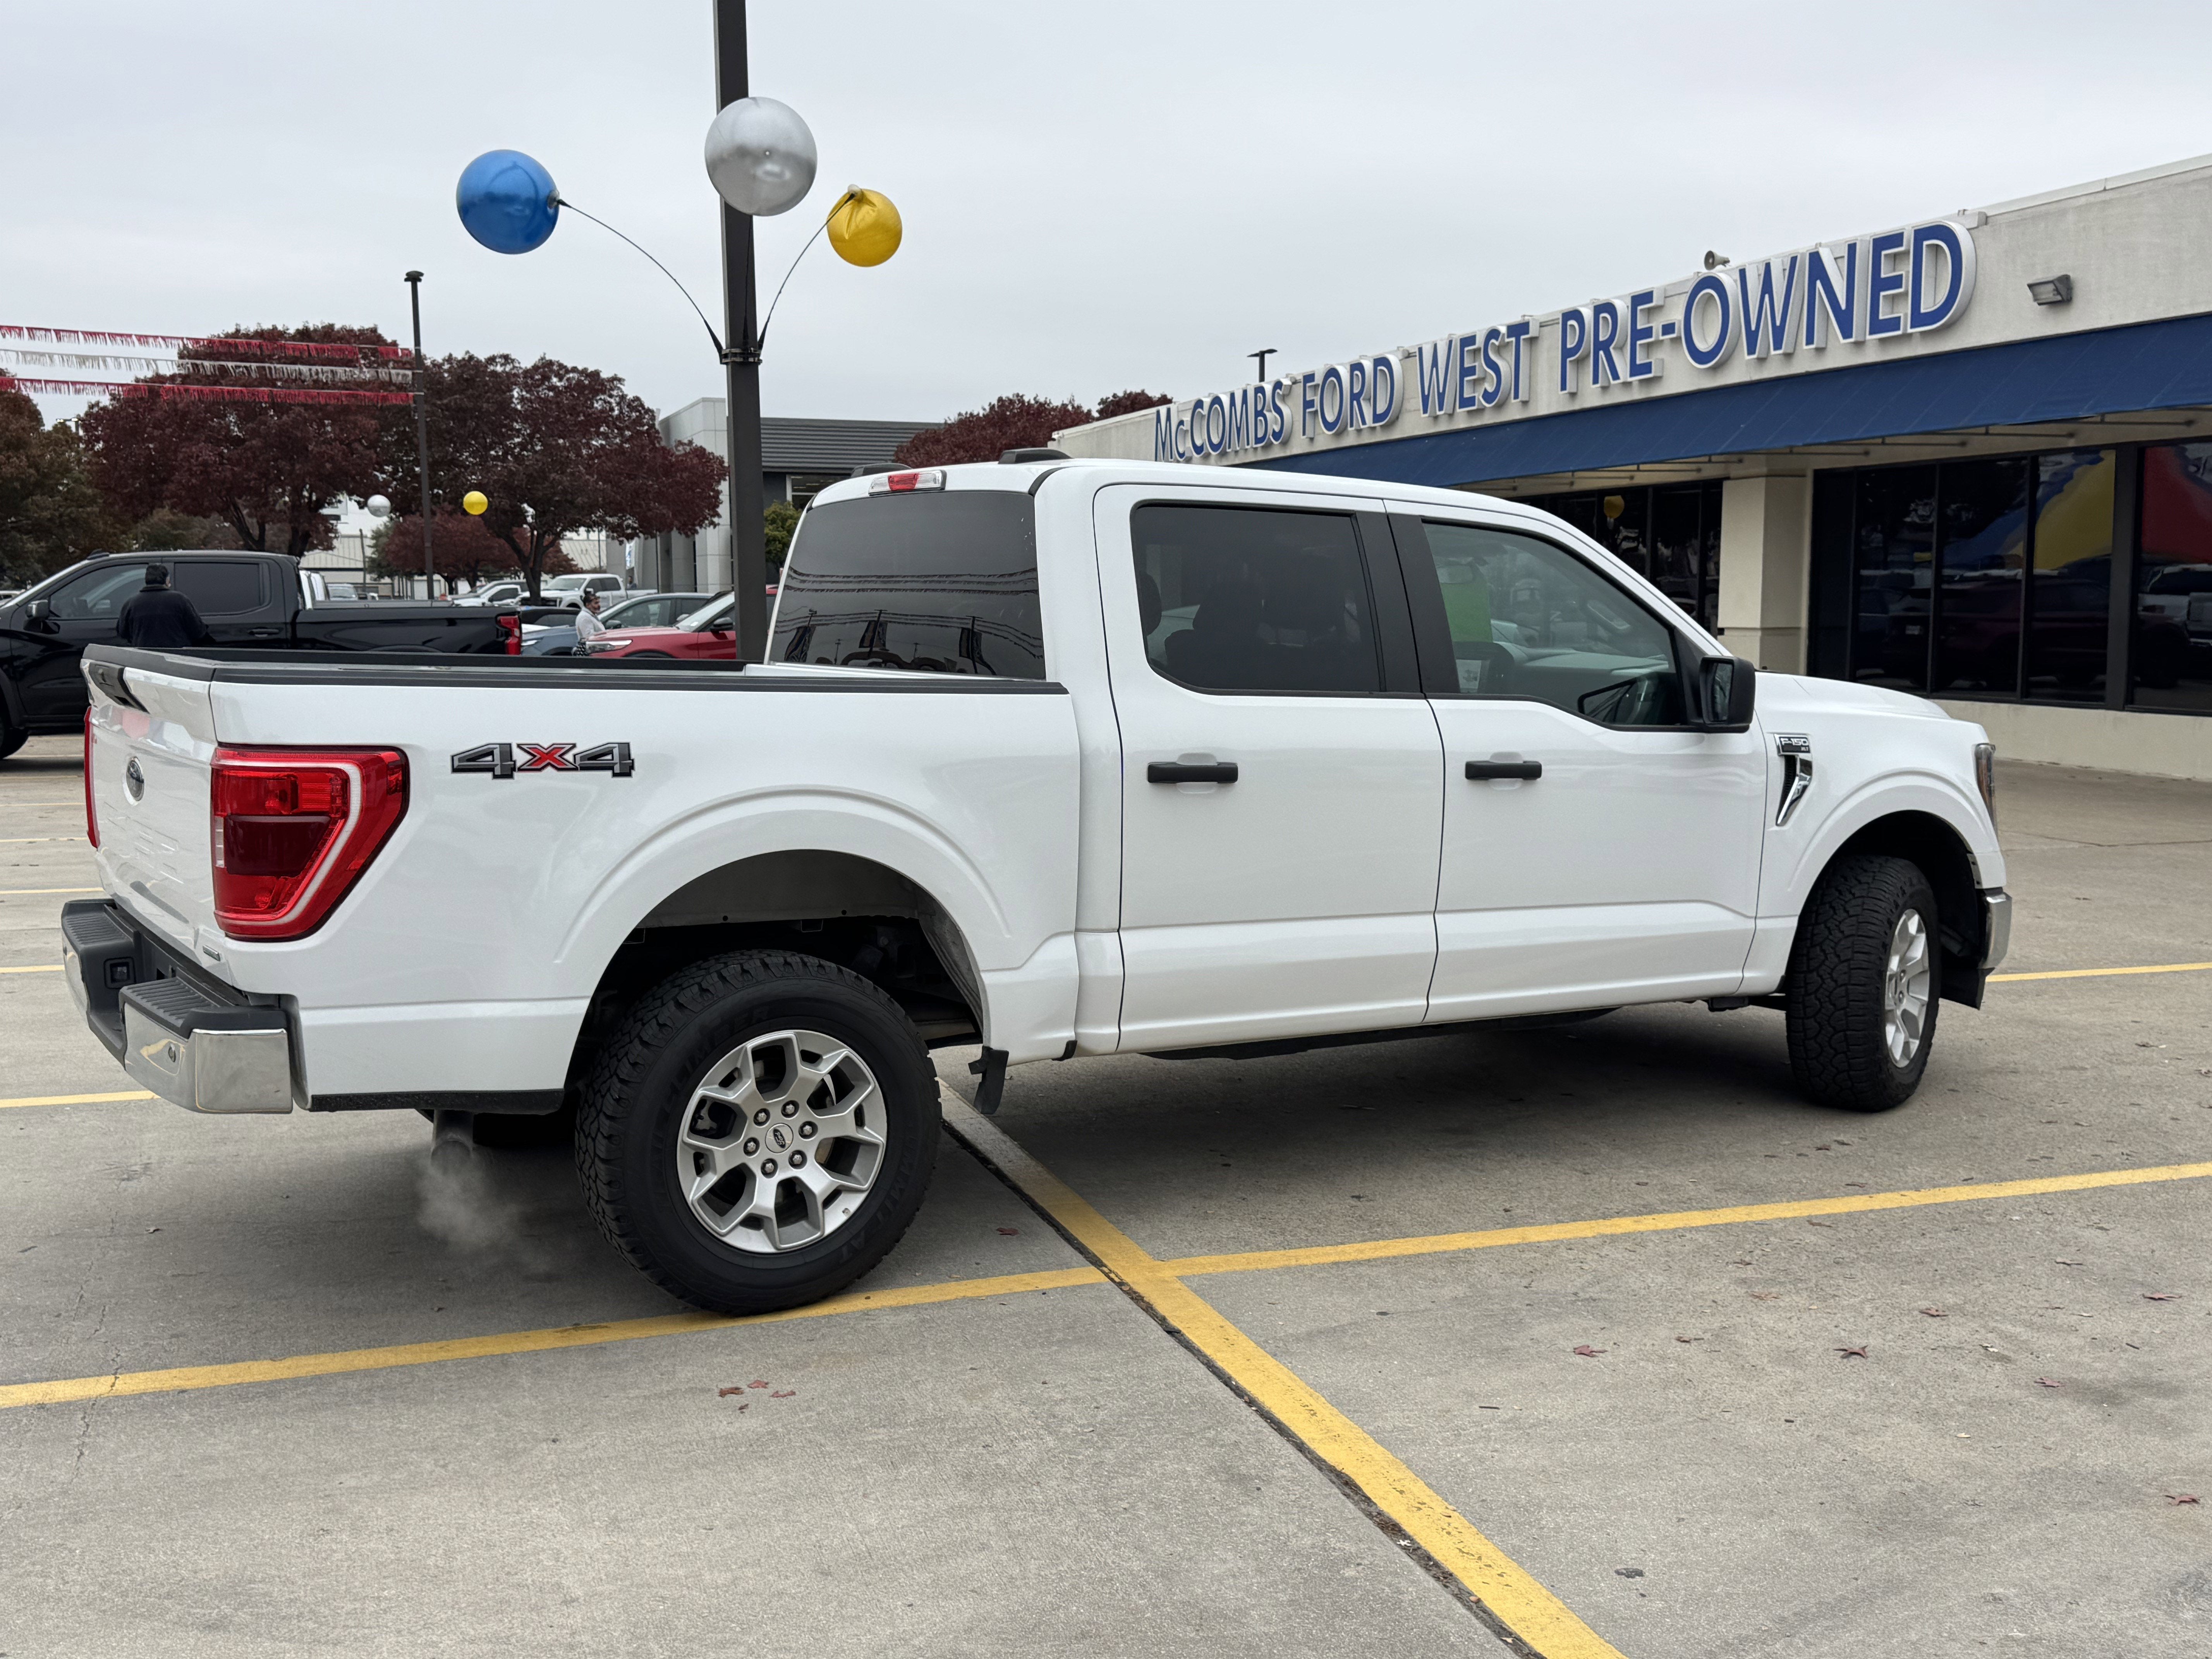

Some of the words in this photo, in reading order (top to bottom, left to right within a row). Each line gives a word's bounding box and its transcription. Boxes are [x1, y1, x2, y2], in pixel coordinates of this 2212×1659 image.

[1154, 377, 1291, 462] McCOMBS
[1302, 354, 1403, 438] FORD
[1417, 318, 1539, 417] WEST
[1559, 220, 1976, 394] PRE-OWNED
[1781, 738, 1809, 746] F-150
